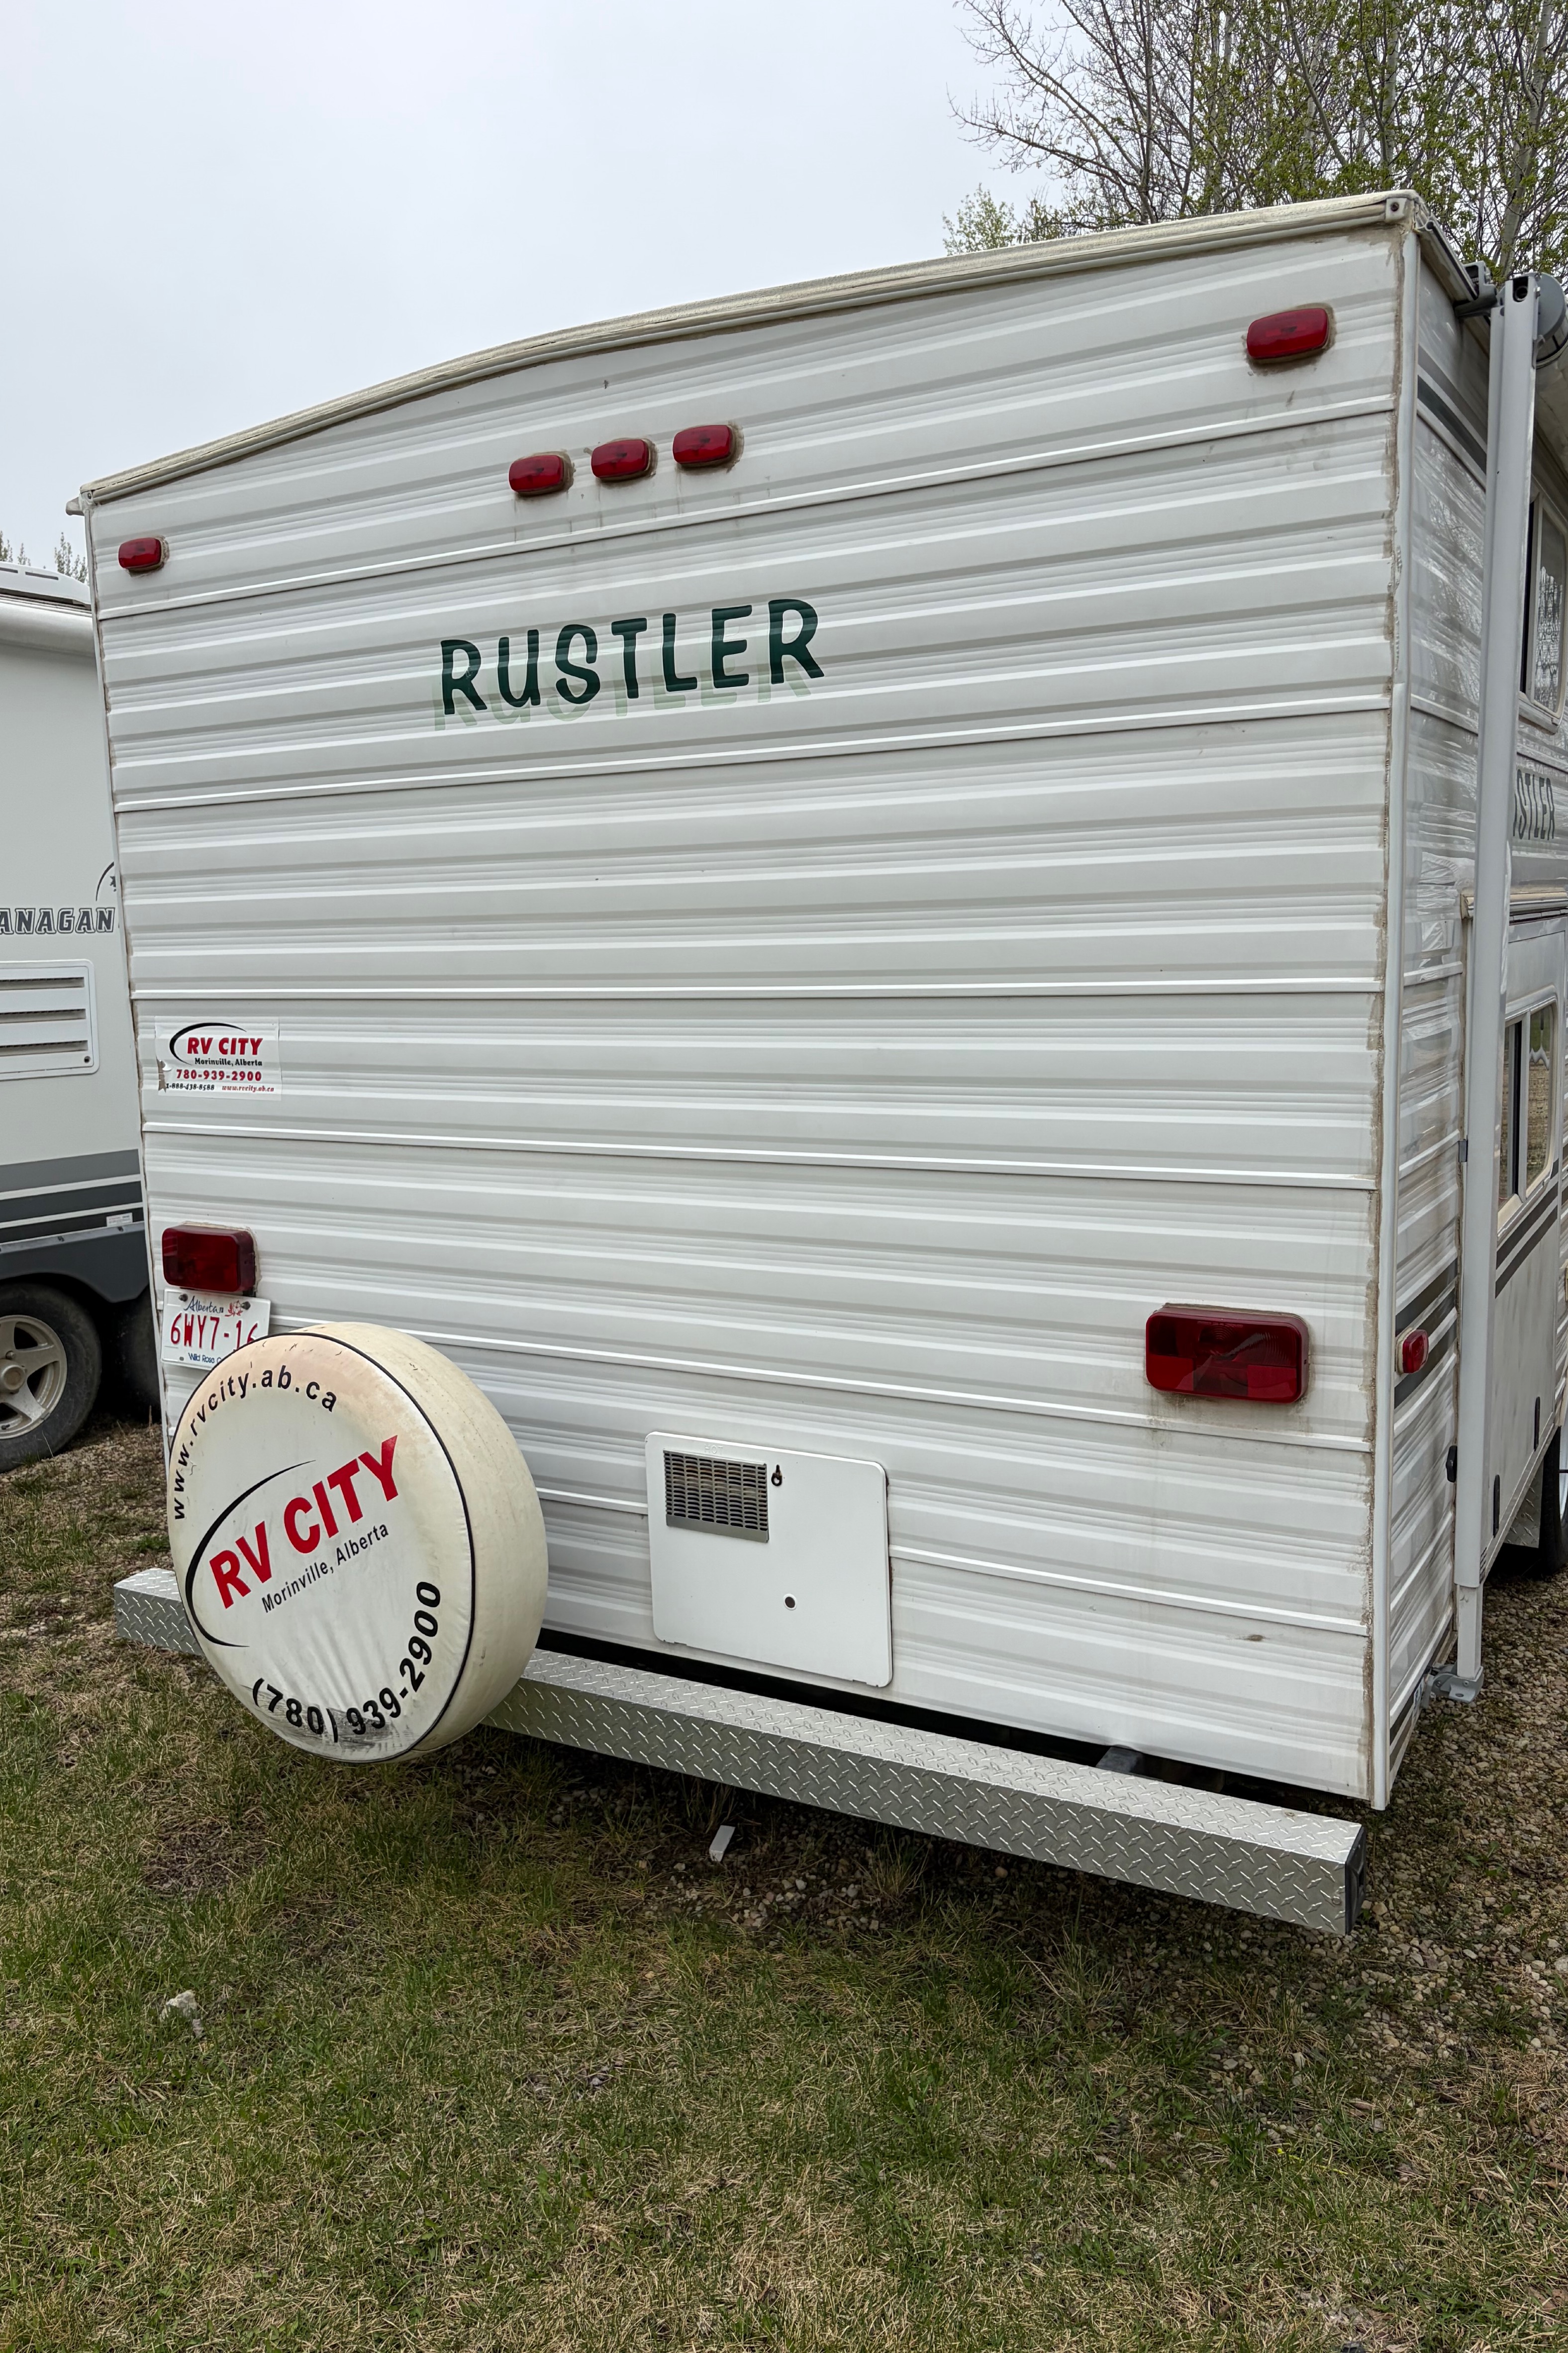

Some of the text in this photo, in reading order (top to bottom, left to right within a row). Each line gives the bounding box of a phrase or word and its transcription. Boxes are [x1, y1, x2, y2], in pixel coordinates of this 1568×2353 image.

[440, 599, 825, 716] RUSTLER
[187, 1037, 263, 1055] RV CITY
[195, 1058, 234, 1067] Morinville,
[176, 1069, 262, 1082] 780-939-2900
[184, 1295, 224, 1314] Alberta
[188, 1352, 200, 1361] Wild
[202, 1354, 215, 1364] Rose
[174, 1364, 337, 1520] www.rvcity.ab.ca
[209, 1436, 398, 1609] RV CITY
[262, 1524, 389, 1613] Morinville, Alberta
[252, 1581, 441, 1743] (780) 939-2900
